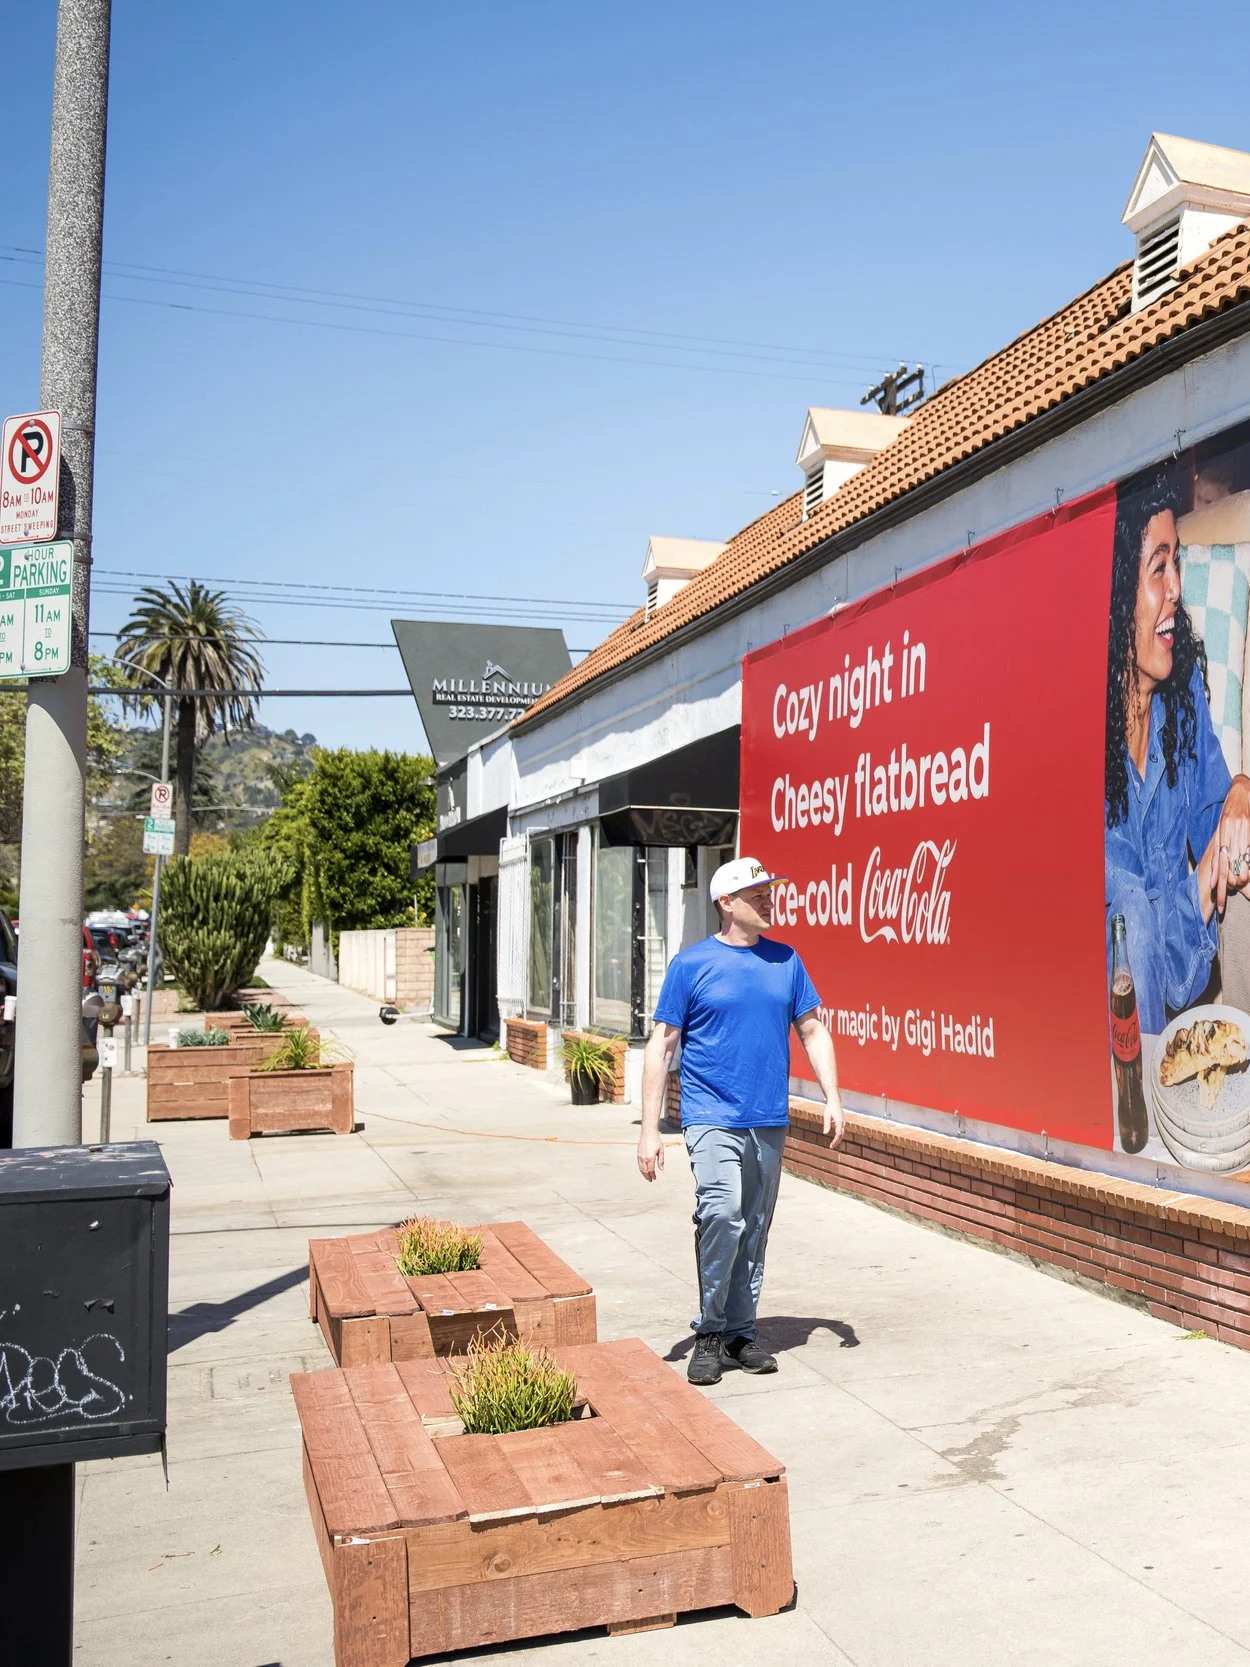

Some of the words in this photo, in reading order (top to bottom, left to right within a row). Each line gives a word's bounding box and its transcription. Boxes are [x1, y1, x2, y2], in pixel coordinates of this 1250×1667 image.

[16, 509, 39, 519] MONDAY
[1, 523, 21, 534] STREET
[24, 520, 54, 531] SWEEPING
[27, 547, 55, 561] HOUR
[13, 559, 67, 588] PARKING
[39, 587, 60, 596] SUNDAY
[432, 678, 550, 697] MILLENNIU
[773, 680, 823, 742] Cozy
[828, 640, 894, 729] night
[901, 629, 926, 698] in
[436, 693, 456, 701] REAL
[457, 694, 484, 703] ESTATE
[771, 773, 849, 837] Cheesy
[854, 722, 990, 818] flatbread
[859, 838, 957, 945] Coca-Cola
[837, 1003, 878, 1046] magic
[881, 1005, 901, 1051] by
[904, 1008, 936, 1057] Gigi
[940, 1013, 995, 1058] Hadid
